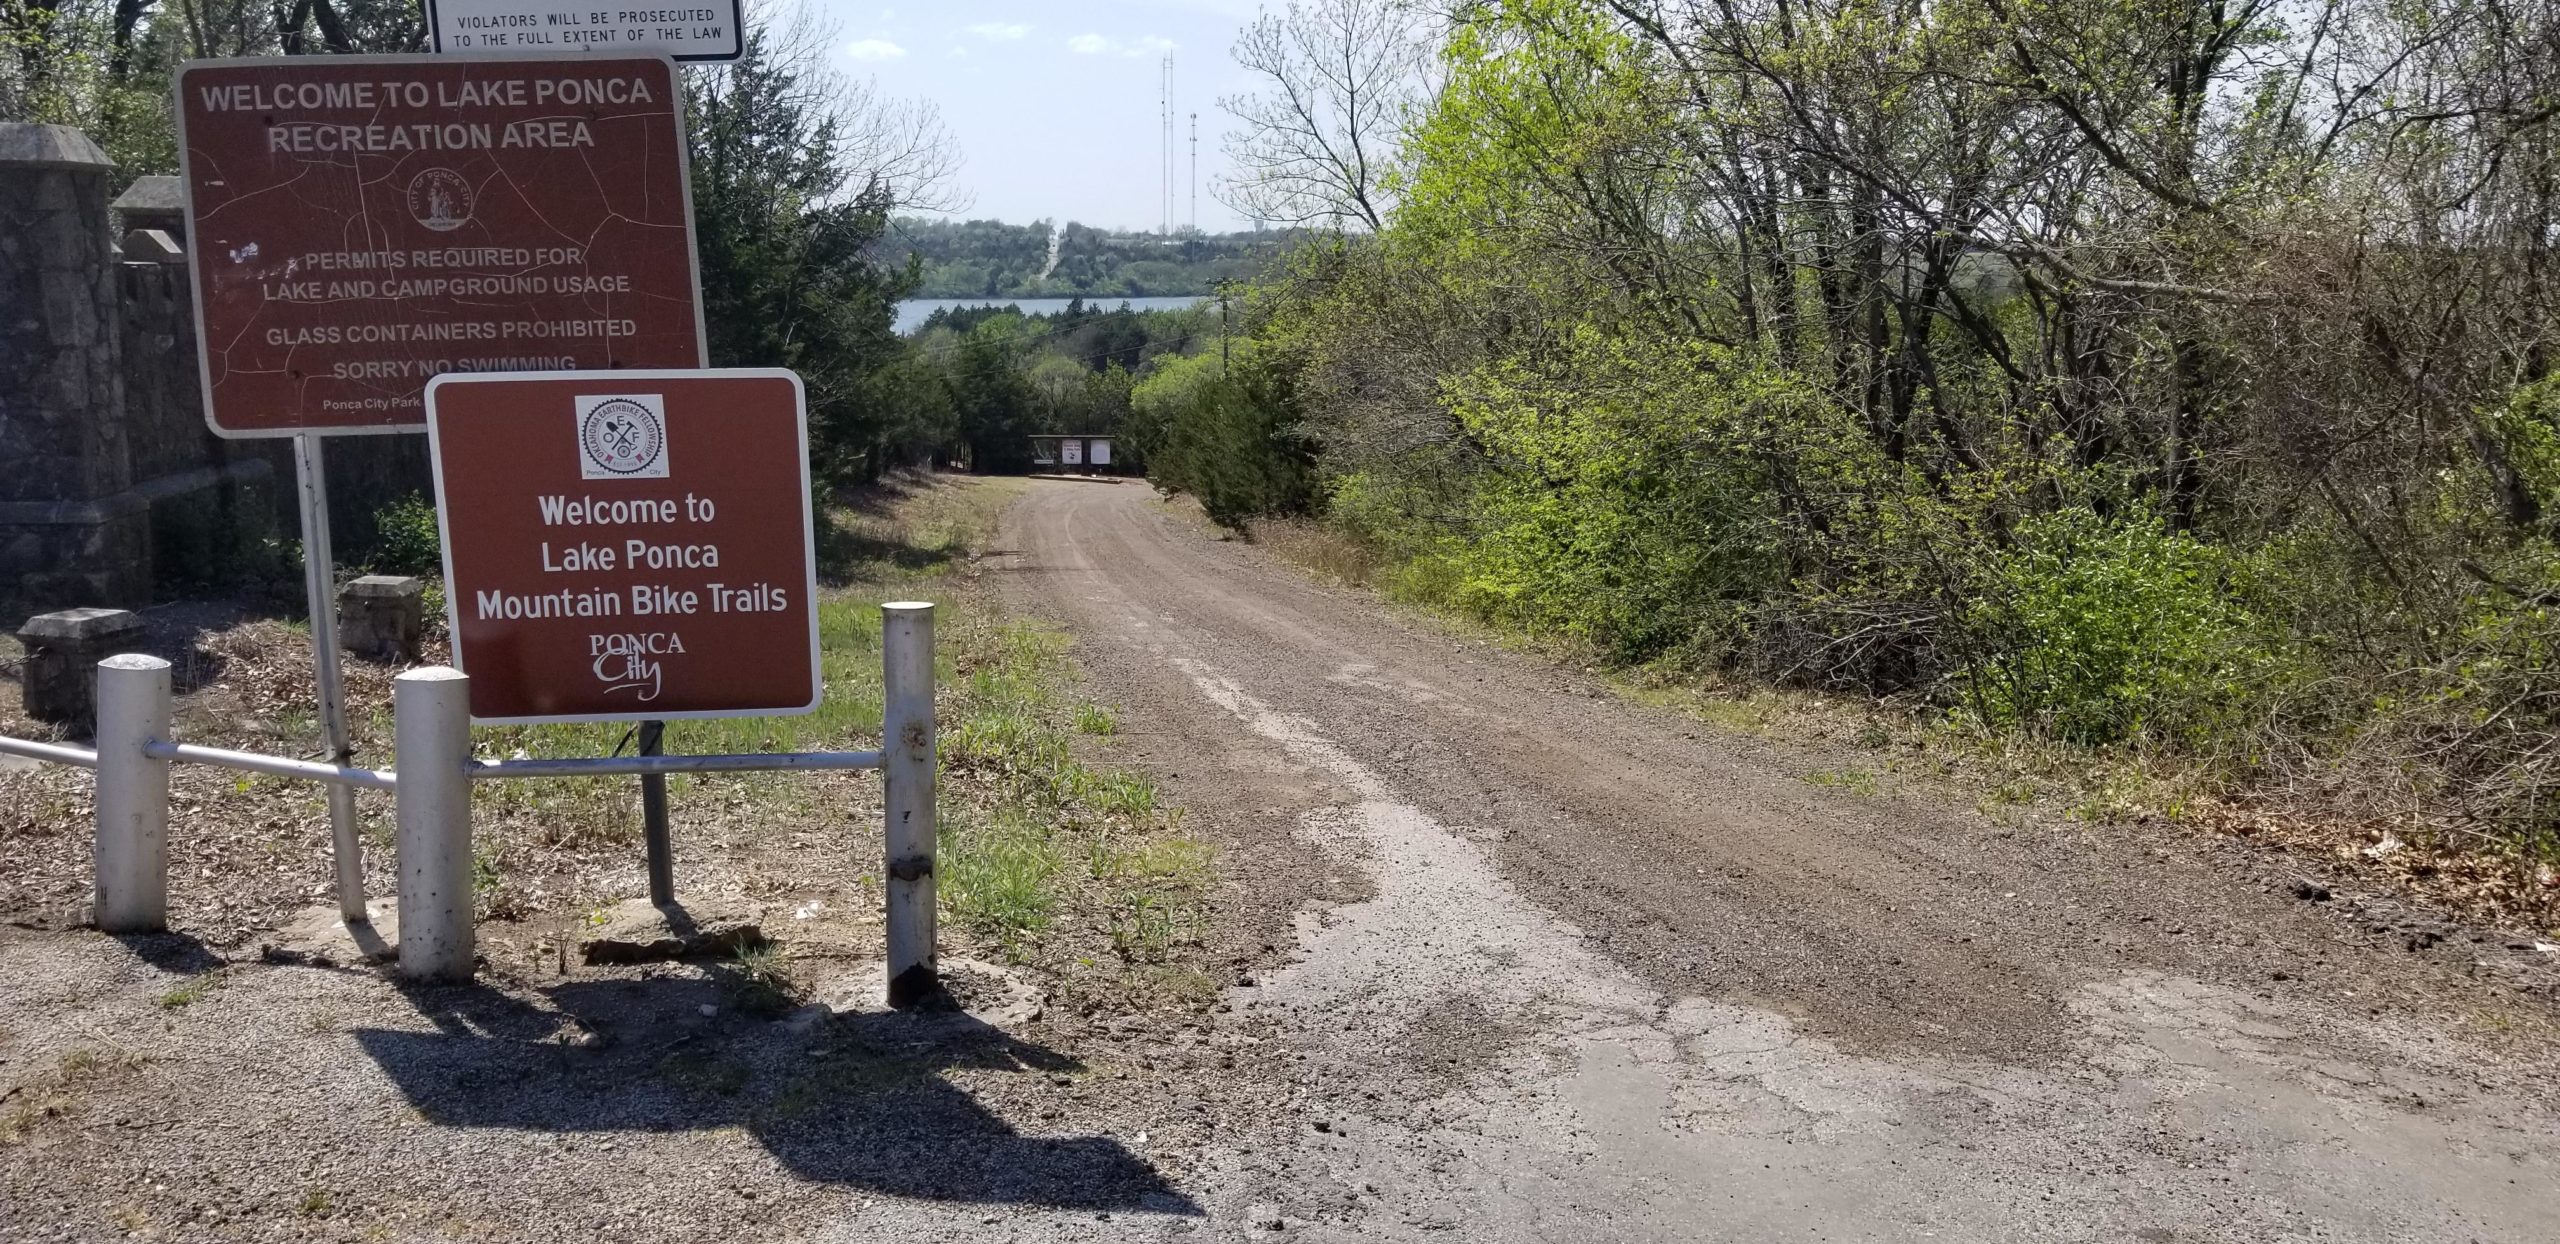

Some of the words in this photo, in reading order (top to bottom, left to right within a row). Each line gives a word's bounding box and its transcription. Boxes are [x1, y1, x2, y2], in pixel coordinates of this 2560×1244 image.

[458, 14, 537, 29] VIOLATORS
[547, 12, 580, 26] WILL
[590, 12, 609, 24] BE
[619, 9, 714, 23] PROSECUTED
[454, 35, 471, 48] TO
[480, 34, 508, 46] THE
[518, 32, 553, 44] FULL
[563, 29, 616, 44] EXTENT
[627, 28, 645, 41] OF
[656, 28, 683, 40] THE
[693, 26, 722, 39] LAW
[201, 82, 377, 112] WELCOME
[384, 82, 430, 108] TO
[438, 79, 527, 108] LAKE
[536, 78, 653, 106] PONCA
[268, 123, 492, 154] RECREATION
[500, 122, 596, 150] AREA
[305, 250, 406, 270] PERMITS
[412, 248, 530, 269] REQUIRED
[536, 247, 582, 266] FOR
[264, 283, 322, 301] LAKE
[328, 281, 375, 298] AND
[381, 277, 548, 298] CAMPGROUND
[553, 276, 630, 295] USAGE
[266, 326, 341, 346] GLASS
[346, 322, 496, 344] CONTAINERS
[502, 318, 636, 340] PROHIBITED
[333, 360, 414, 380] SORRY
[418, 359, 454, 377] NO
[458, 355, 576, 373] SWIMMING
[323, 399, 362, 410] Ponca
[364, 398, 389, 411] City
[588, 416, 604, 458] OKLAHOMA
[598, 404, 640, 418] EARTHBIKE
[638, 413, 656, 457] FELLOWSHIP
[538, 494, 677, 526] Welcome
[686, 492, 715, 523] to
[542, 542, 616, 572] Lake
[627, 539, 719, 570] Ponca
[476, 588, 622, 620] Mountain
[632, 585, 698, 616] Bike
[706, 582, 788, 614] Trails
[589, 632, 686, 656] PONCA
[593, 642, 662, 701] City
